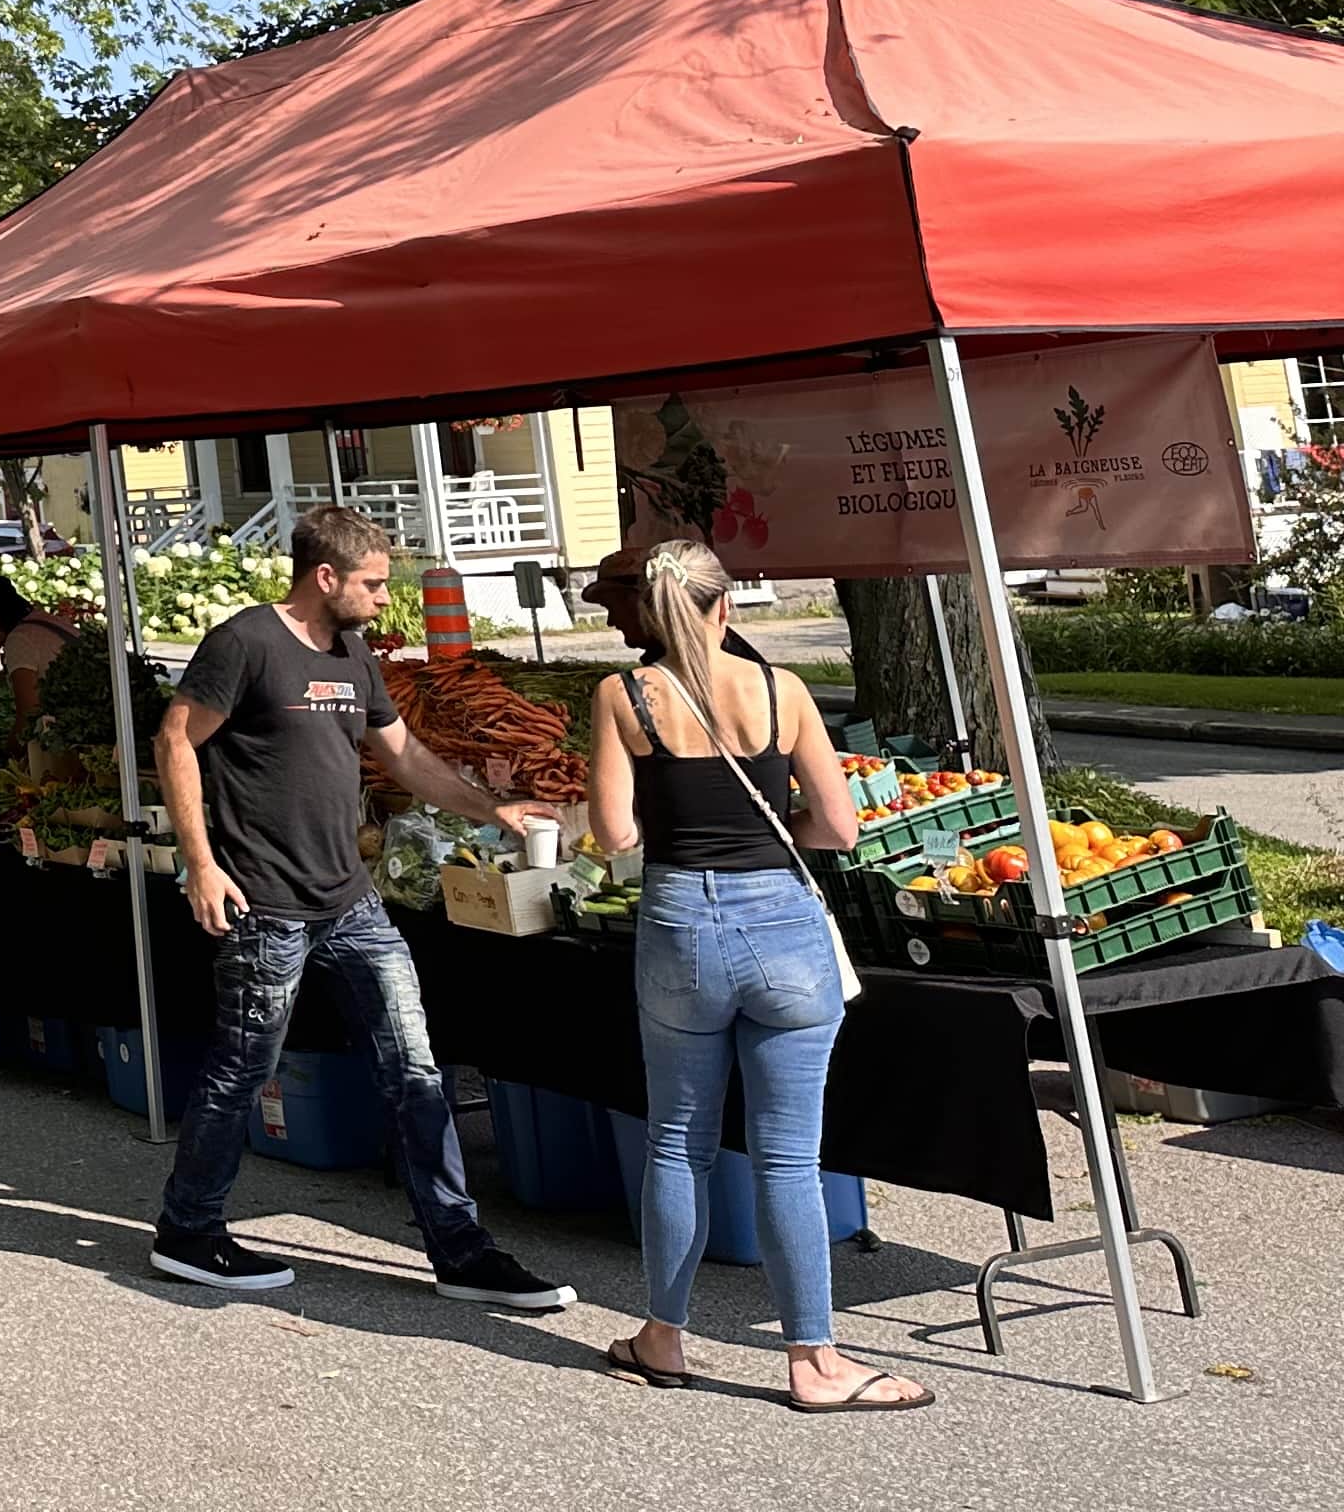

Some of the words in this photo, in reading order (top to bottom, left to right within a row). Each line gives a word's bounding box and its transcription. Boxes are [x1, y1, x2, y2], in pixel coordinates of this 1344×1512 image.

[846, 428, 947, 454] LÉGUMES
[851, 463, 876, 484] ET
[880, 458, 953, 482] FLEUR
[1029, 464, 1046, 478] LA
[1055, 456, 1143, 476] BAIGNEUSE
[837, 488, 956, 515] BIOLOGIQU
